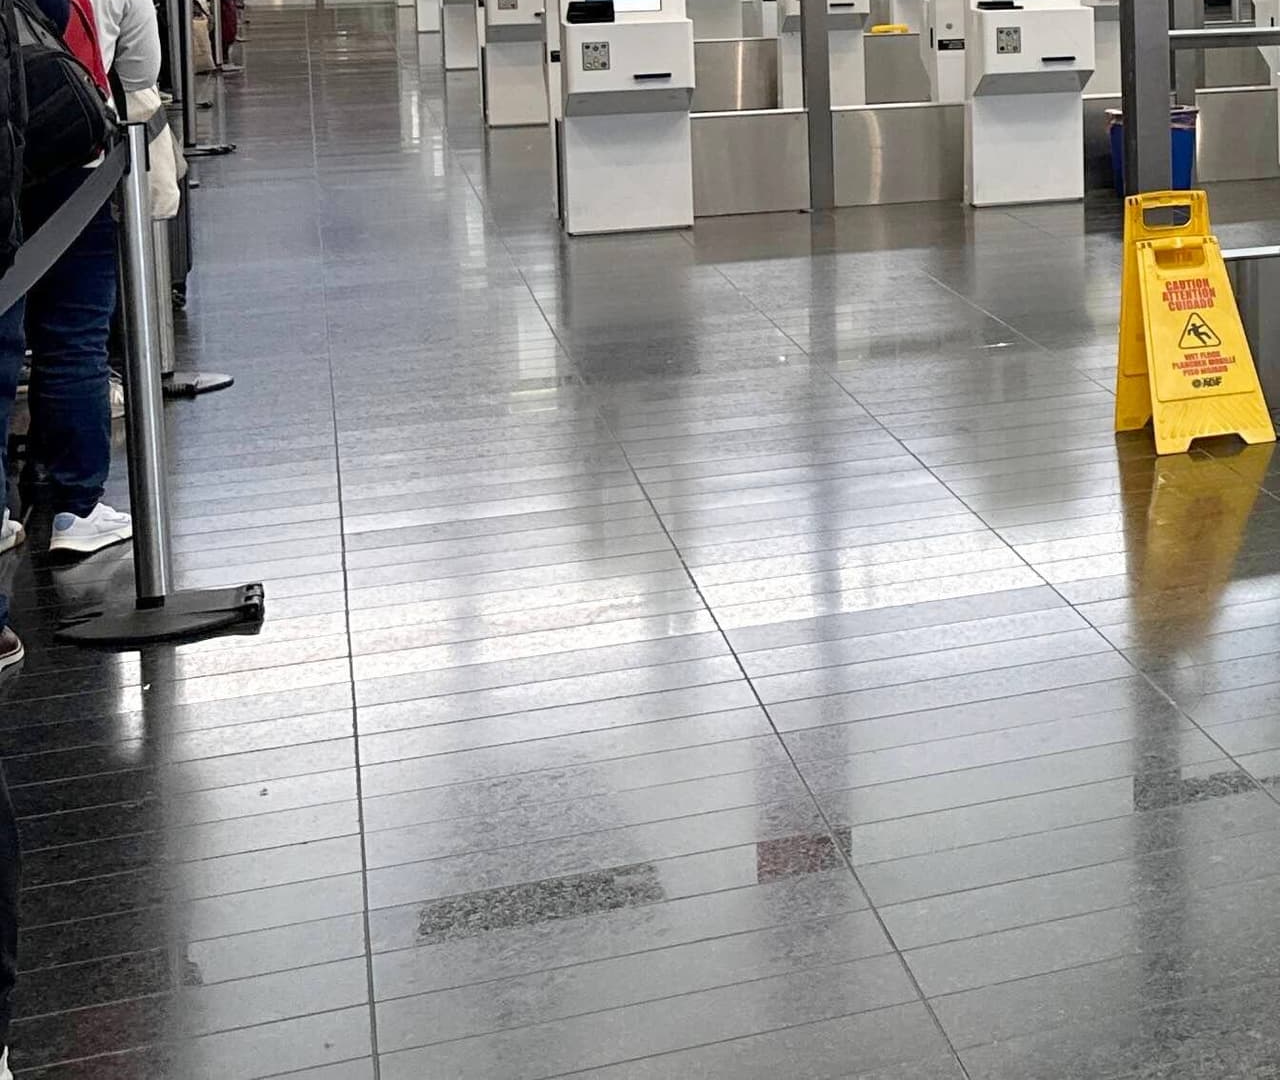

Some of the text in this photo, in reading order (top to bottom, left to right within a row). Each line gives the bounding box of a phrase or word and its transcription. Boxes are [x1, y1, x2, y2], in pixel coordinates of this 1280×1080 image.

[1165, 278, 1210, 292] CAUTION
[1162, 287, 1217, 302] ATTENTION
[1168, 298, 1215, 312] CUIDADO
